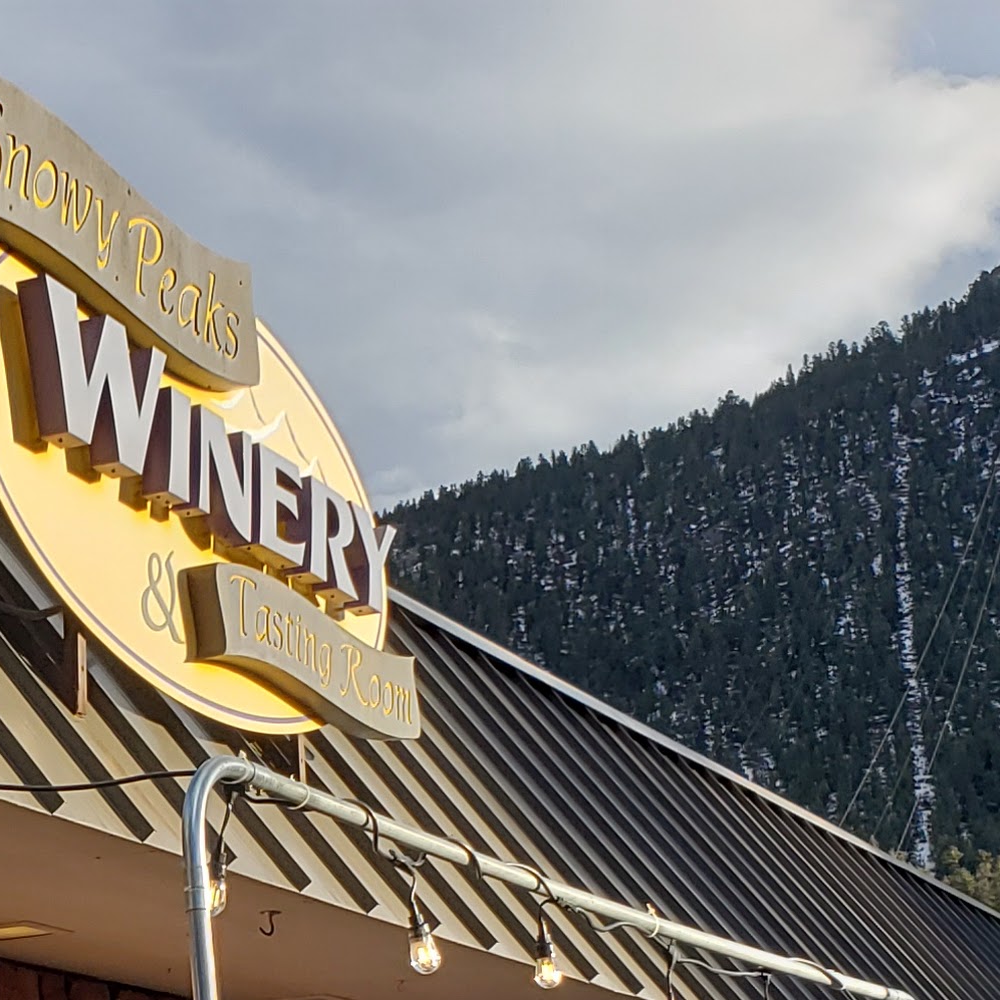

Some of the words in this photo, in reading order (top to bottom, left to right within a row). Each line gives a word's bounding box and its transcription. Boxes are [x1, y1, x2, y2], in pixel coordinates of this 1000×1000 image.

[128, 217, 240, 360] Peaks
[44, 272, 397, 614] WINERY
[140, 549, 185, 644] &
[230, 574, 332, 688] Tasting
[340, 643, 413, 725] Room
